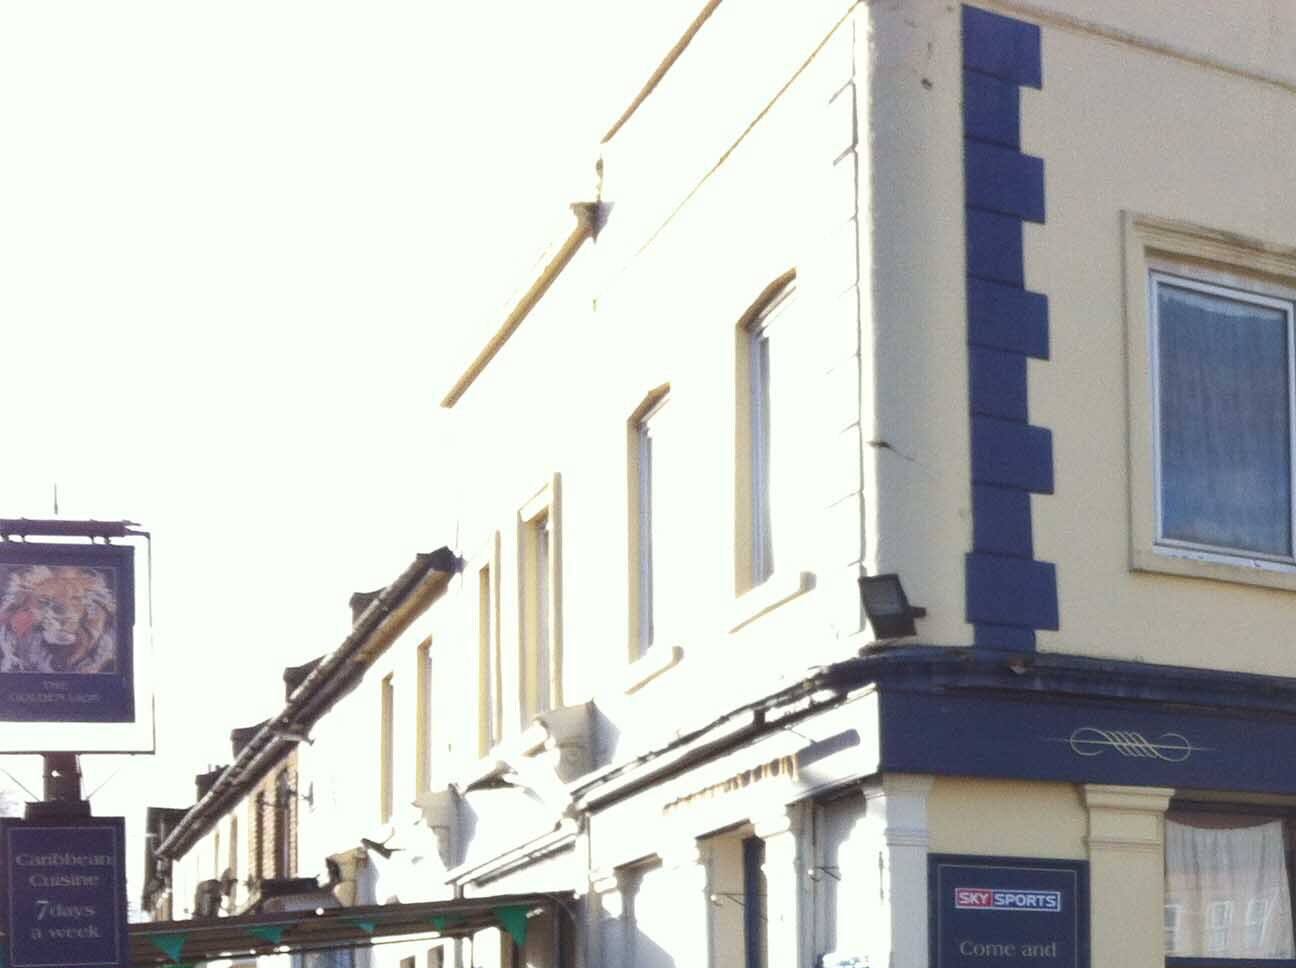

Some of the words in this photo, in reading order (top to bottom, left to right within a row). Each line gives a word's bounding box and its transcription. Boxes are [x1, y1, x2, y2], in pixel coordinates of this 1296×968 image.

[959, 891, 990, 905] SKY
[994, 892, 1057, 908] SPORTS
[960, 940, 1016, 957] Come
[1022, 943, 1057, 958] and
